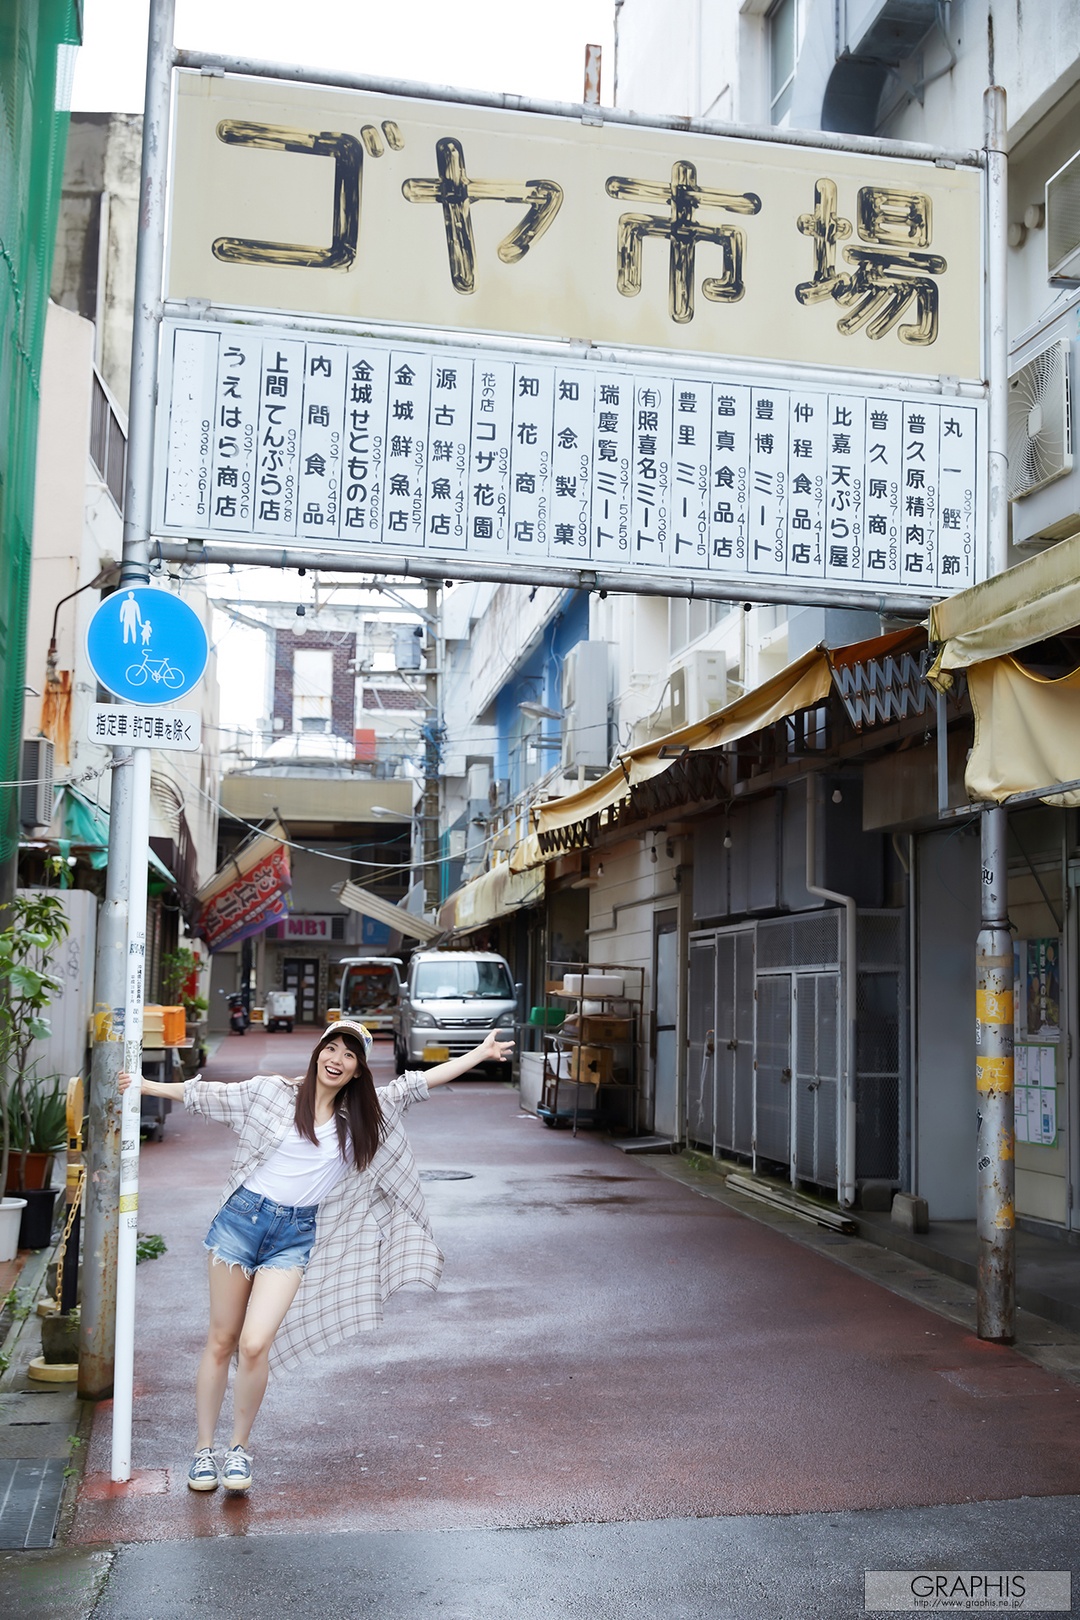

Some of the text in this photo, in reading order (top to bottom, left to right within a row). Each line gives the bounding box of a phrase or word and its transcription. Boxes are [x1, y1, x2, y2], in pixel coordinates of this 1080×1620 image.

[211, 117, 948, 348] ゴヤ市場
[214, 346, 247, 517] うえはら商店
[240, 423, 254, 519] 937-0320
[258, 350, 289, 522] 上間てんぷら店
[283, 428, 297, 523] 937-8328
[302, 355, 332, 525] 内間食品
[326, 431, 341, 526] 937-0494
[344, 359, 375, 528] 金城せともの店
[388, 363, 417, 532] 金城鮮魚店
[473, 372, 498, 539] 花の店 コザ花園
[513, 375, 540, 542] 知花商店
[553, 379, 580, 546] 知念製菓
[675, 391, 697, 555] 豊里ミート
[713, 394, 736, 558] 當真食品店
[369, 435, 383, 530] 937-4666
[412, 440, 425, 533] 937-4557
[454, 443, 466, 537] 937-4319
[496, 447, 508, 540] 937-6410
[536, 450, 549, 543] 937-2669
[577, 454, 589, 547] 937-7099
[618, 457, 629, 551] 937-5259
[657, 461, 669, 553] 937-0361
[696, 464, 708, 556] 937-4015
[735, 466, 747, 559] 938-4163
[753, 398, 774, 561] 豊博ミート
[774, 471, 785, 563] 937-7039
[791, 402, 814, 564] 仲程食品店
[813, 475, 824, 566] 937-4114
[829, 405, 852, 568] 比嘉天ぷら屋
[851, 478, 862, 569] 937-8192
[867, 409, 889, 570] 普久原商店
[888, 481, 899, 571] 937-0283
[904, 413, 926, 573] 普久原精肉店
[925, 485, 936, 574] 937-7314
[963, 489, 973, 577] 937-3011
[288, 919, 327, 936] MB1
